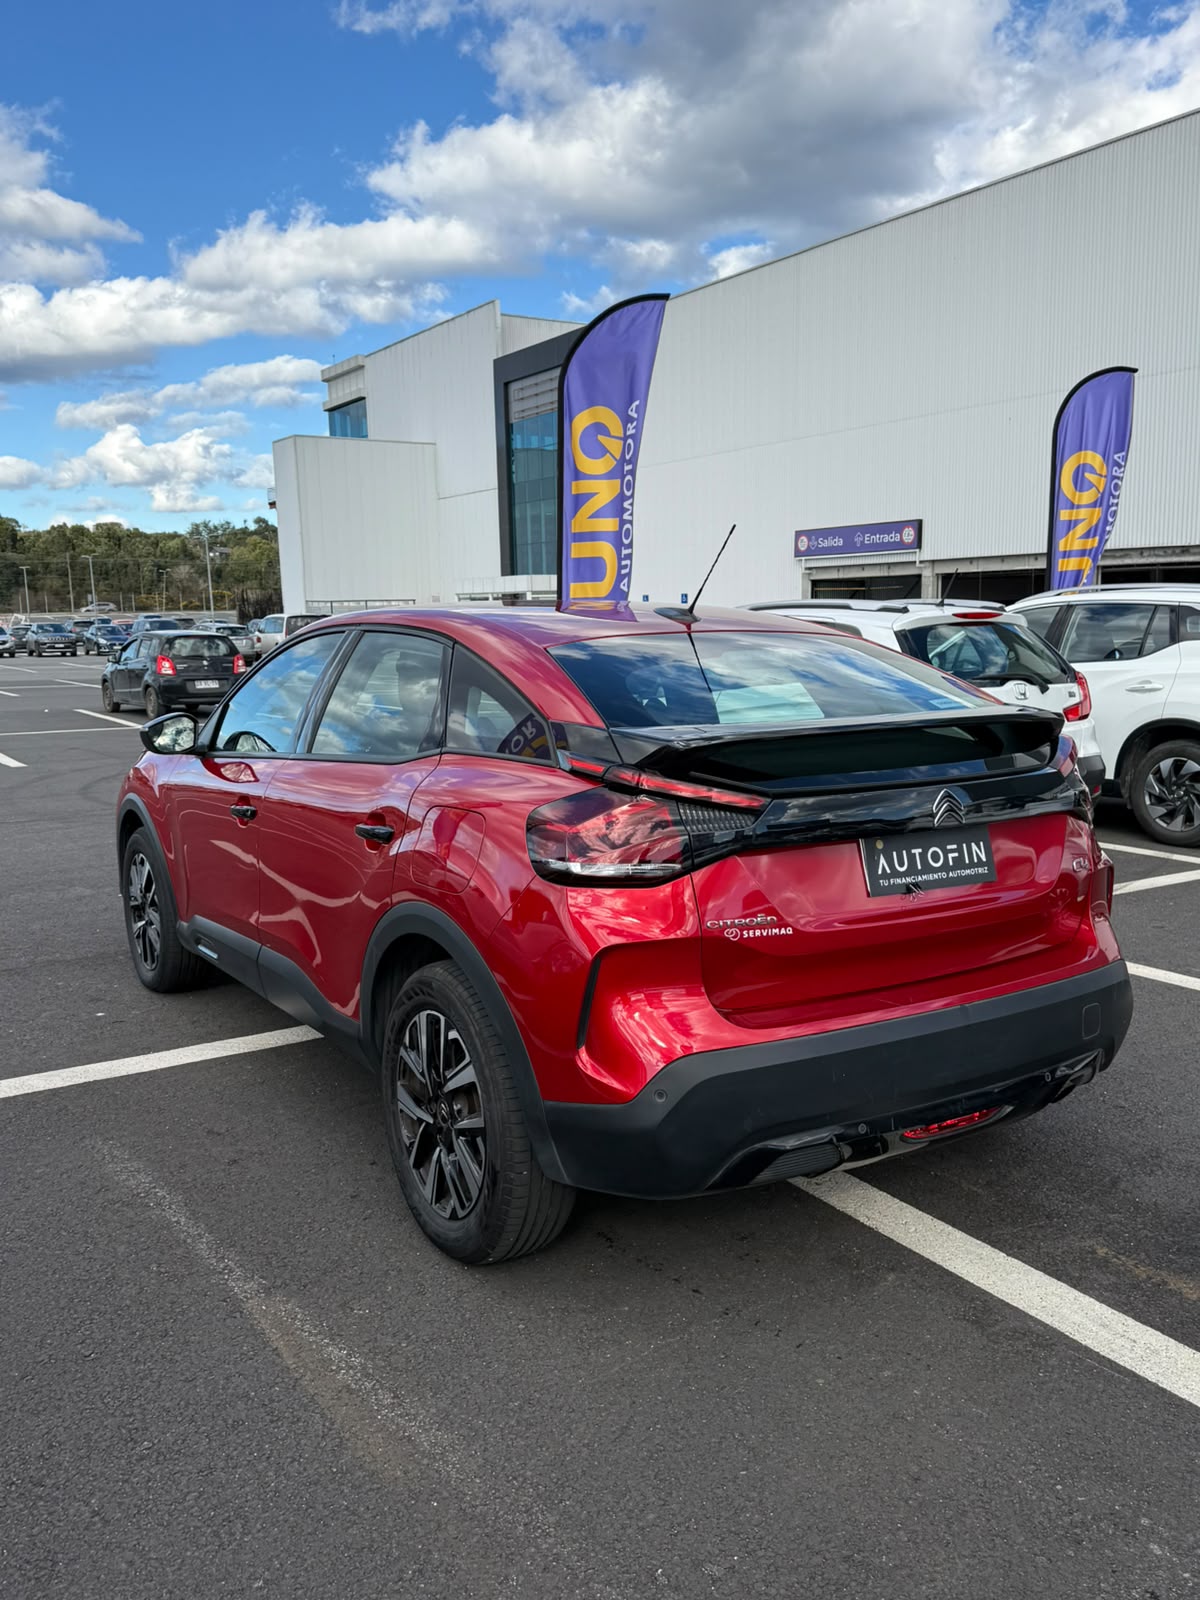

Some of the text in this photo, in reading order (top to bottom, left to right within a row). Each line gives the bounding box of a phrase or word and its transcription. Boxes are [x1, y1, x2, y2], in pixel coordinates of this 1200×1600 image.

[570, 406, 624, 599] UNO
[620, 400, 640, 592] AUTOMOTORA
[818, 536, 843, 548] Salida
[864, 531, 900, 544] Entrada
[878, 841, 987, 875] AUTOFIN
[890, 872, 947, 885] FINANCIAMIENTO
[948, 866, 989, 879] AUTOMOTRIZ
[742, 926, 793, 938] SERVIMAQ
